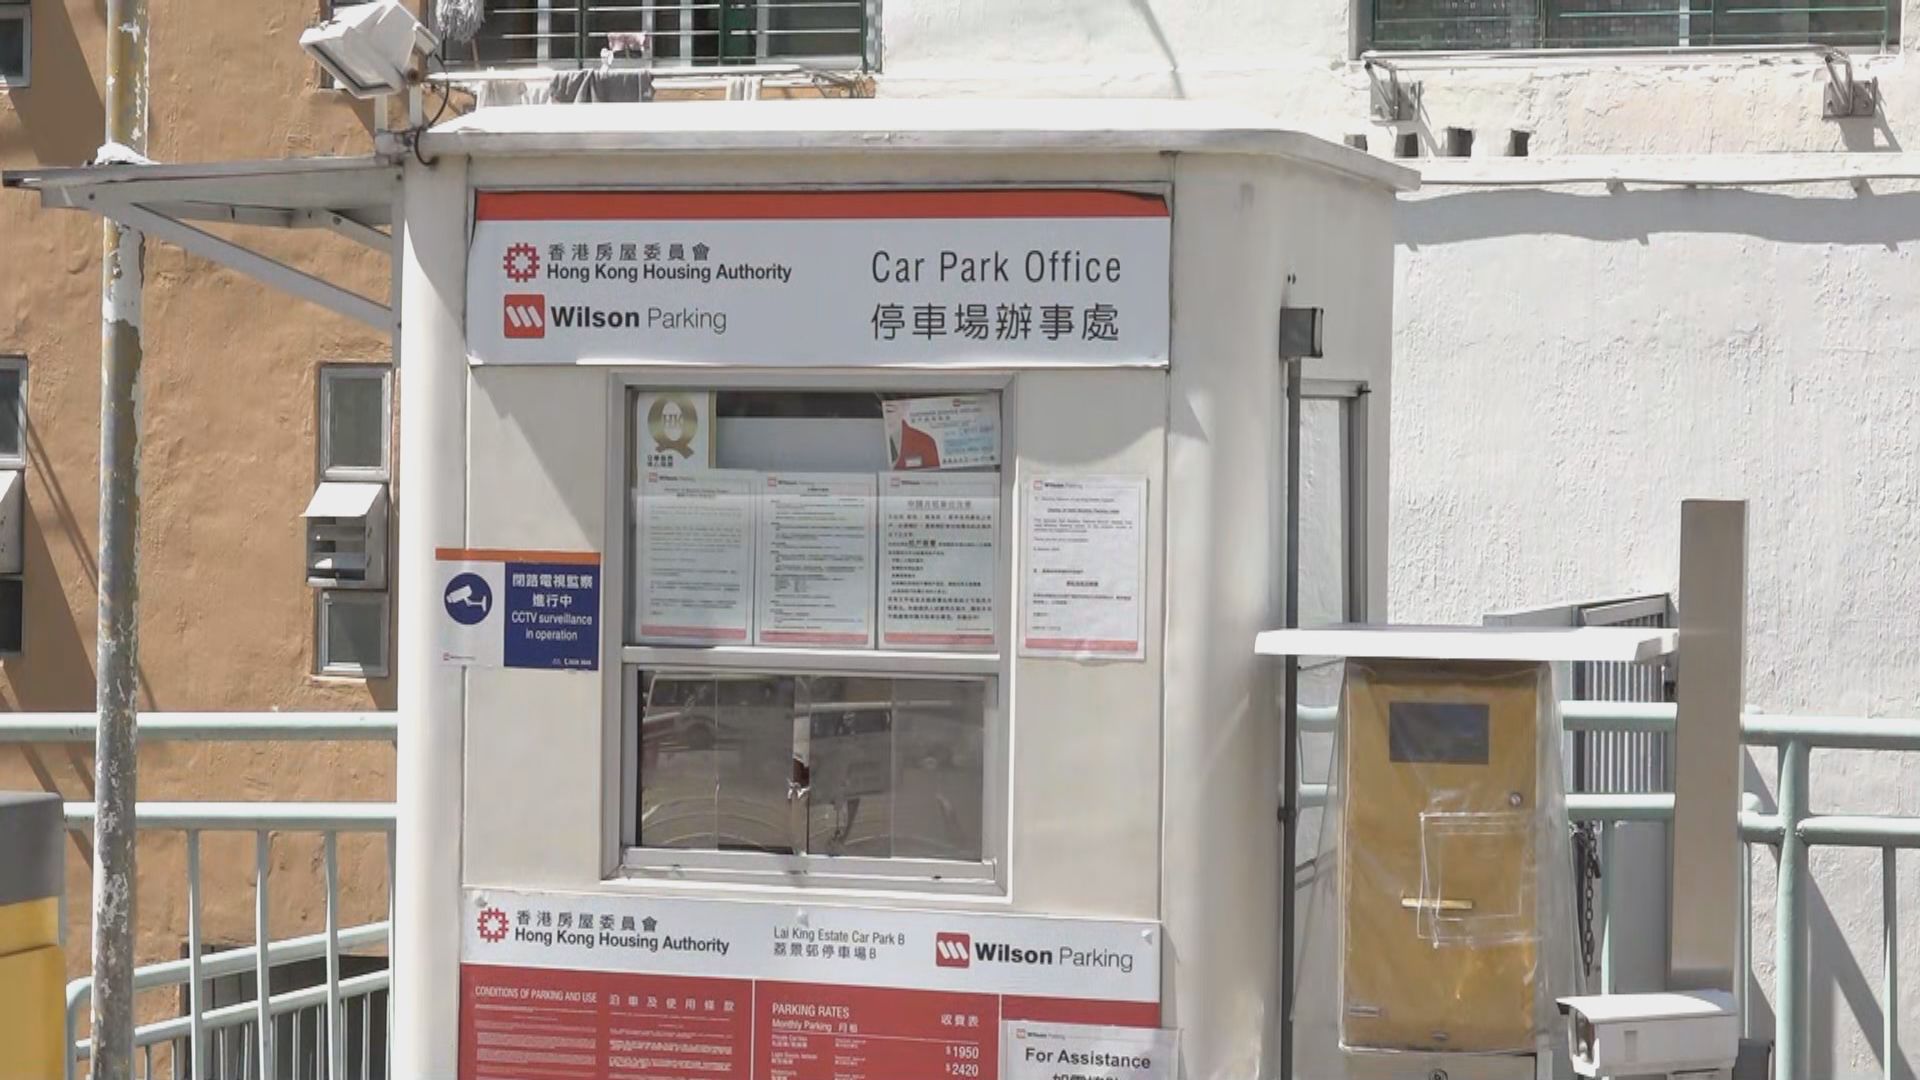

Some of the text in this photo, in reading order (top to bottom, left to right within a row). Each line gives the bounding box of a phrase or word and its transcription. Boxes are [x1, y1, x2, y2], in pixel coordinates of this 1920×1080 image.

[548, 242, 710, 262] 香港房屋委員會
[547, 263, 792, 284] Hong Kong Housing Authority
[871, 250, 1121, 283] Car Park Office
[550, 306, 727, 334] Wilson Parking
[871, 303, 1119, 342] 停車場辦事處
[512, 573, 593, 590] 閉路電視監察
[532, 593, 573, 607] 進行中
[511, 610, 593, 625] CCTV surveillance
[525, 628, 578, 642] in operation
[516, 910, 658, 932] 香港房屋委員會
[514, 928, 730, 955] Hong Kong Housing Authority
[774, 925, 905, 945] Lai King Estate Car Park B
[975, 942, 1134, 973] Wilson Parking
[475, 986, 597, 1003] CONDITIONS OF PARKING AND USE
[772, 1002, 849, 1019] PARKING RATES
[772, 1018, 832, 1033] Monthly Parking
[945, 1045, 979, 1059] $1950
[1025, 1047, 1151, 1069] For Assistance
[945, 1062, 979, 1077] $2420
